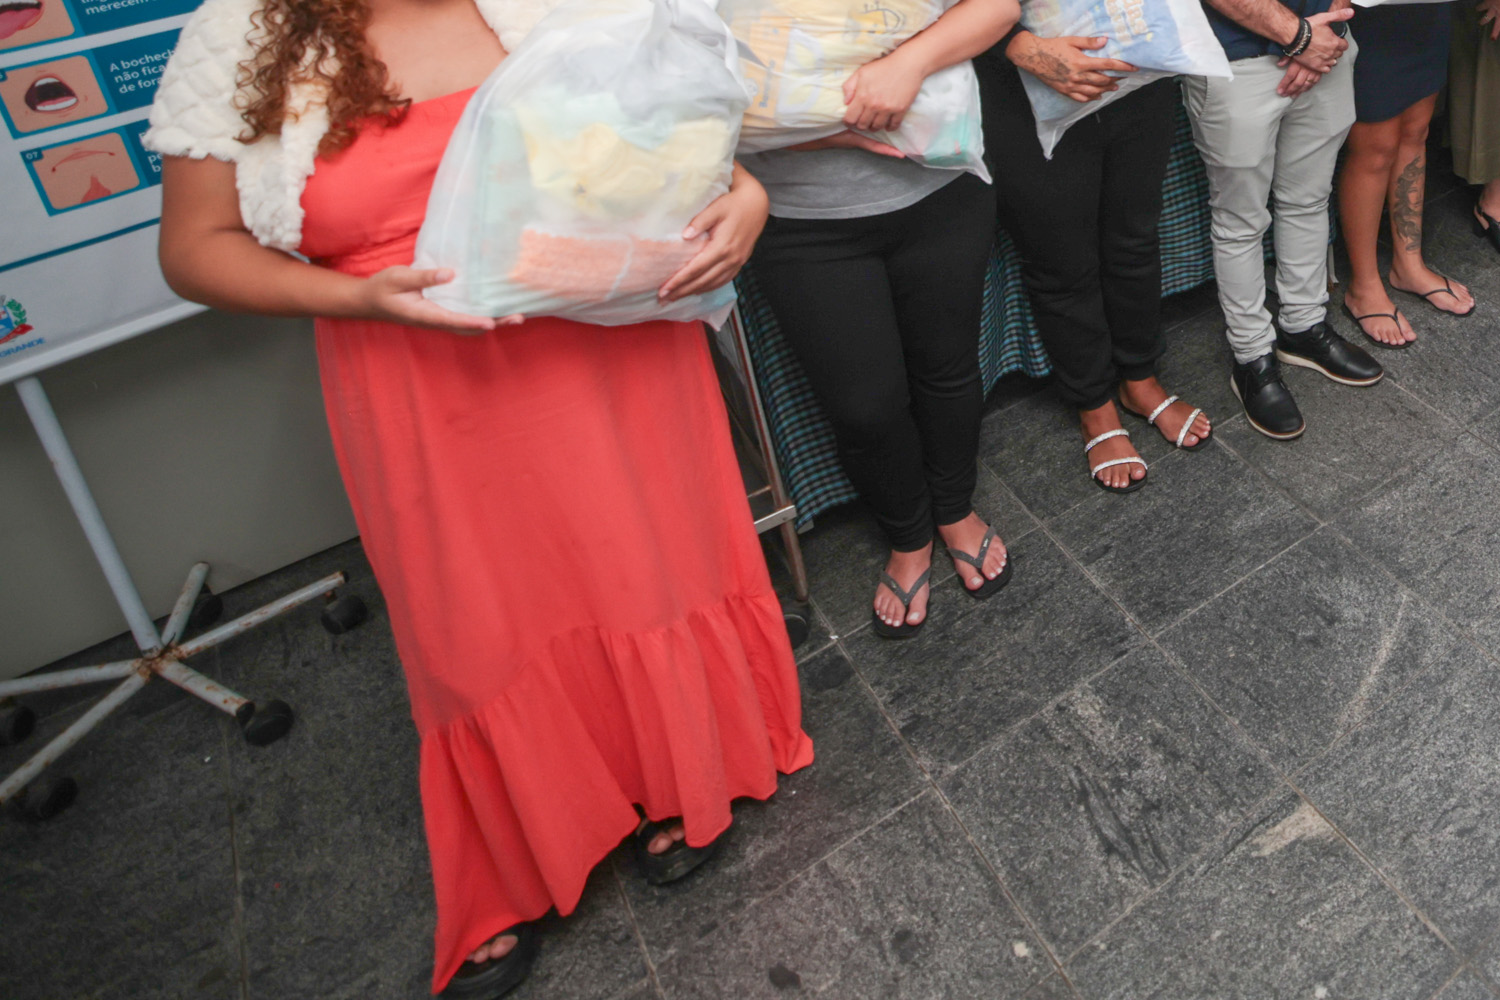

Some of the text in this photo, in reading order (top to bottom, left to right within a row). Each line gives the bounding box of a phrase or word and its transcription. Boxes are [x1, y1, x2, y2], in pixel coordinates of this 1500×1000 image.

[109, 49, 176, 72] A bochech
[114, 71, 140, 83] não
[119, 83, 136, 94] de
[26, 151, 39, 160] 07
